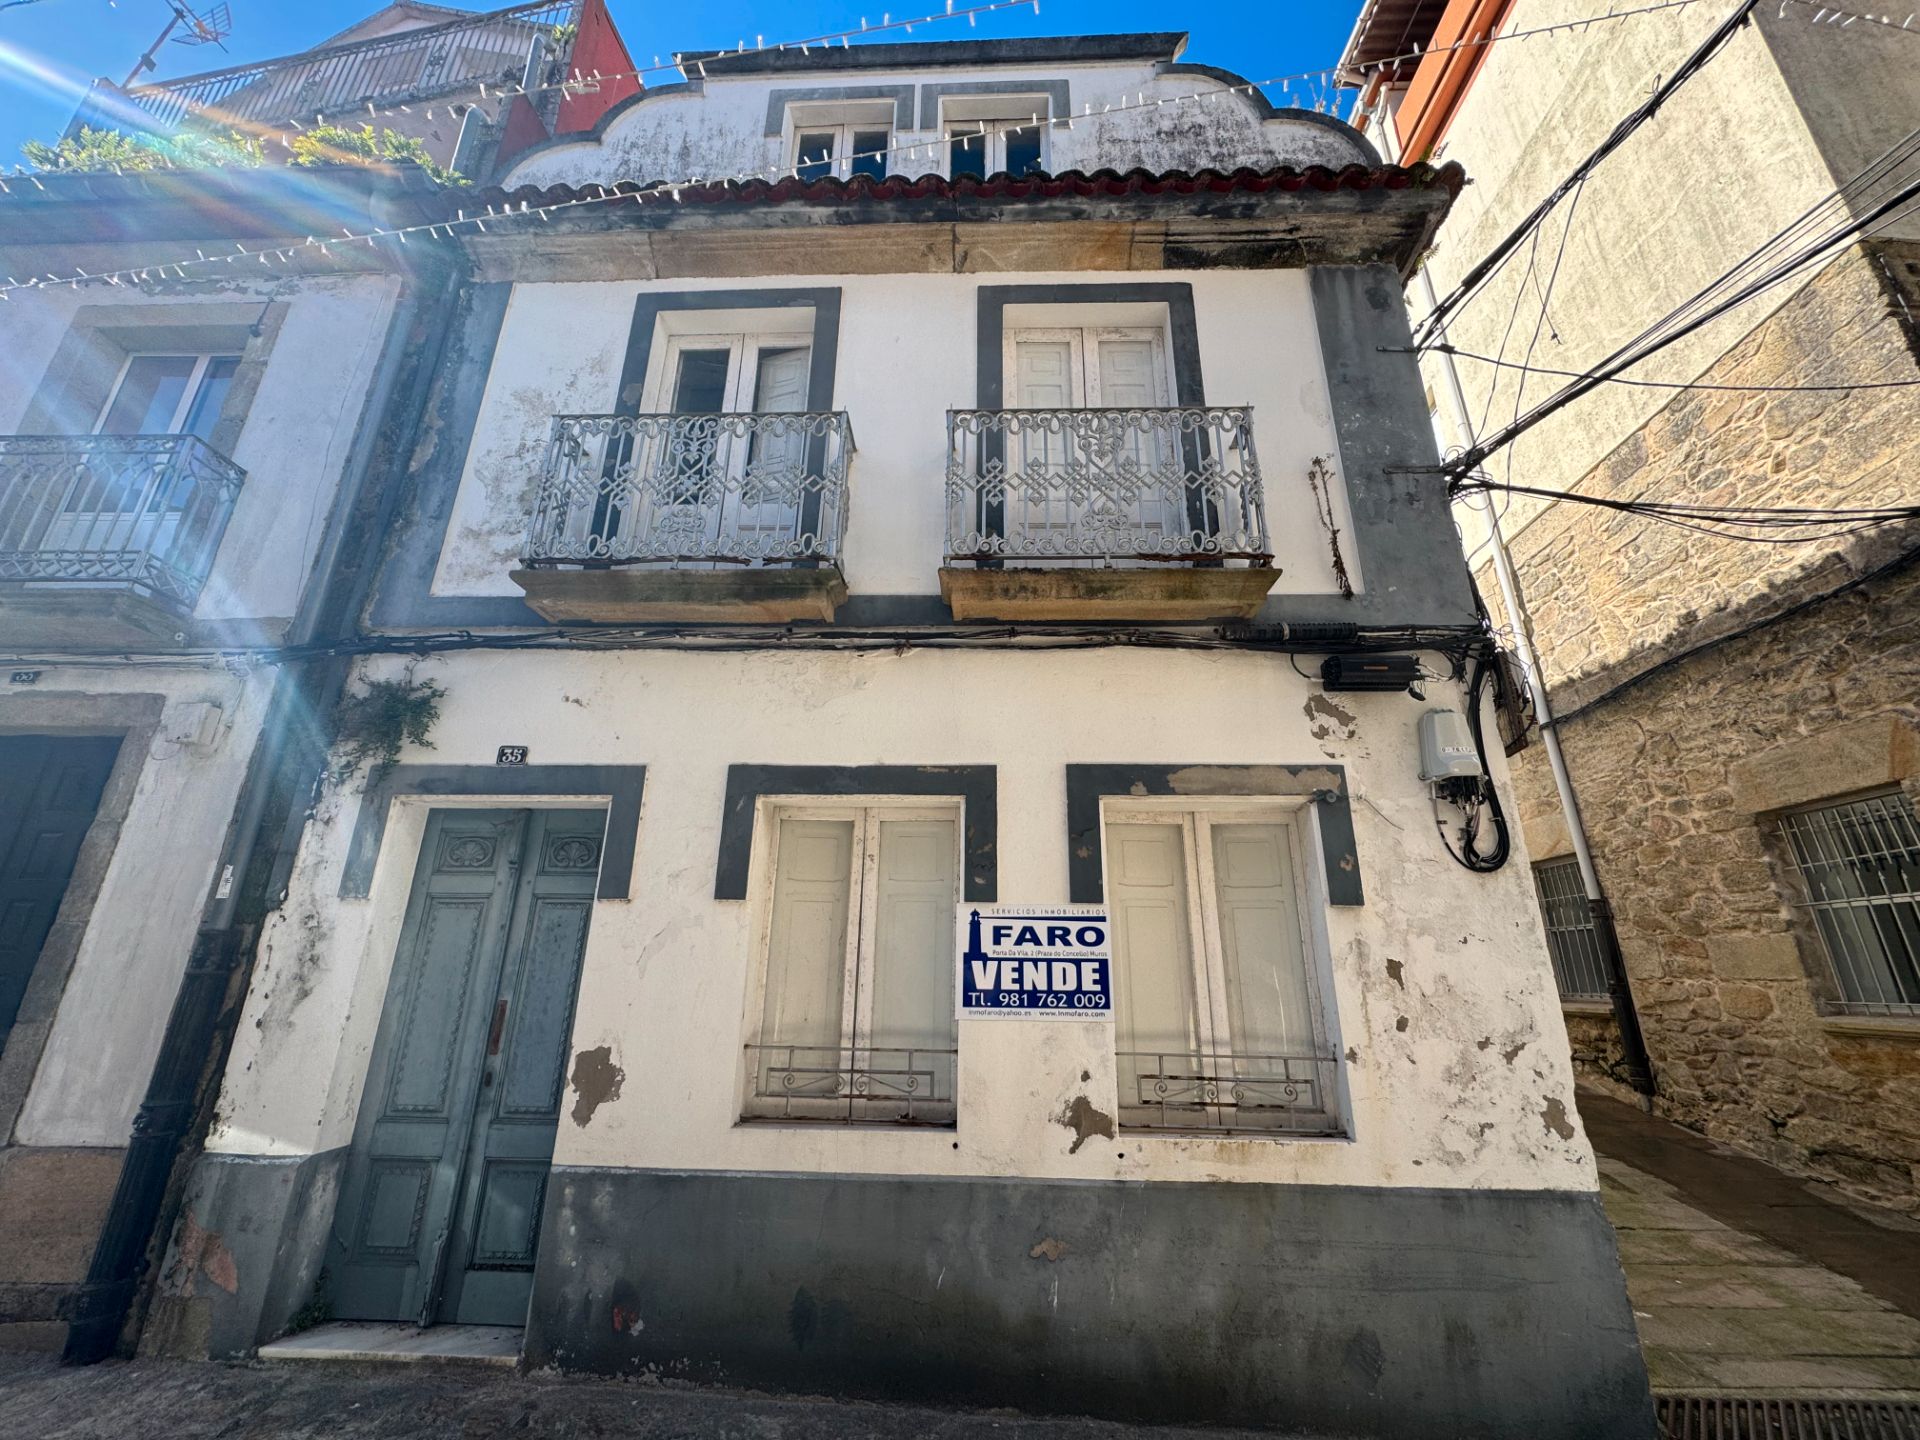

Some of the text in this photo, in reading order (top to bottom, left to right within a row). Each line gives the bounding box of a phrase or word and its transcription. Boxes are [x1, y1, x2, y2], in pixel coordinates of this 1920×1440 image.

[502, 749, 522, 763] 35
[992, 925, 1106, 947] FARO
[971, 960, 1102, 991] VENDE
[968, 992, 1106, 1008] Tl. 981 762 009
